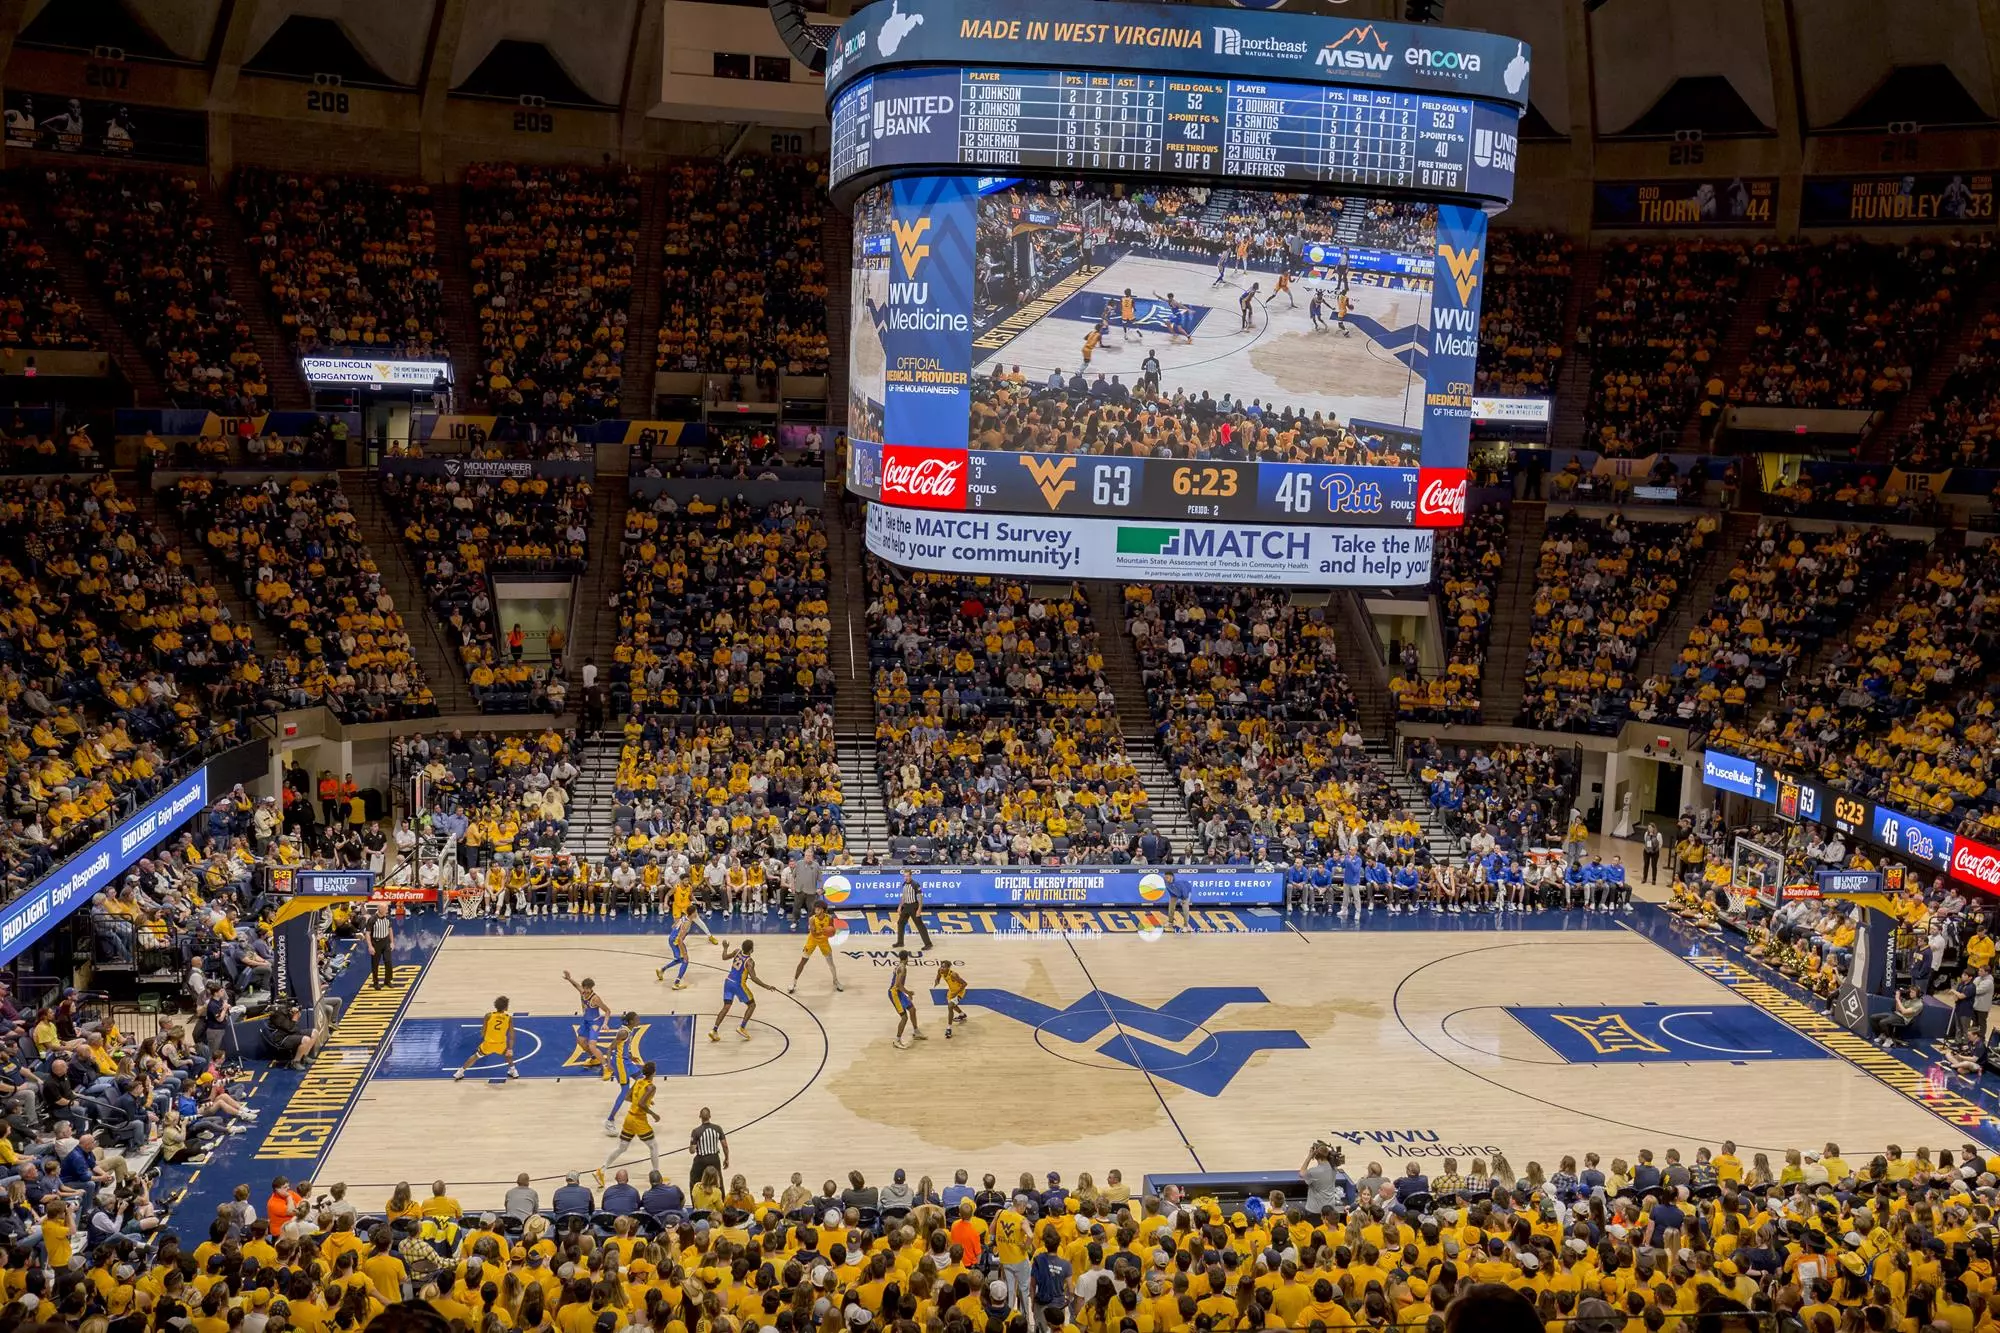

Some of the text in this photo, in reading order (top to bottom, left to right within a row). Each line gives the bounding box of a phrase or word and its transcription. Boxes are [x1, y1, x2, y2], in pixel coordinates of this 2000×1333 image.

[960, 20, 1202, 49] MADE IN WEST VIRGINIA
[1241, 36, 1307, 53] northeast
[1315, 49, 1394, 71] MSW
[1404, 47, 1480, 72] encova
[969, 72, 1134, 86] PLAYER PTS. REB. AST.
[1415, 69, 1469, 79] INSURANCE
[979, 87, 1021, 100] JOHNSON
[1170, 83, 1212, 92] FIELD GOAL
[1237, 85, 1392, 104] PLAYER PTS. REB. AST.
[307, 90, 349, 114] 208
[887, 96, 954, 116] UNITED
[978, 102, 1020, 116] JOHNSON
[1188, 94, 1202, 110] 52
[1245, 100, 1285, 114] ODUKALE
[1422, 102, 1460, 112] FIELD GOAL
[513, 111, 553, 133] 209
[886, 116, 931, 136] BANK
[978, 118, 1017, 132] BRIDGES
[1168, 114, 1199, 122] 3-POINT
[1244, 115, 1279, 130] SANTOS
[1433, 112, 1455, 129] 52.9
[1183, 123, 1205, 140] 42.1
[1231, 130, 1272, 145] 15 GUEYE
[1419, 131, 1446, 140] 3-POINT
[771, 134, 802, 154] 210
[977, 134, 1020, 148] SHERMAN
[1166, 144, 1218, 153] FREE THROWS
[1435, 141, 1448, 158] 40
[976, 150, 1021, 164] COTTRELL
[1175, 153, 1210, 170] 3 OF 8
[1228, 146, 1276, 160] 23 HUGLEY
[1669, 145, 1704, 165] 215
[1228, 162, 1285, 177] 24 JEFFRESS
[1418, 160, 1463, 171] FREE THROWS
[1422, 169, 1457, 187] 8 OF 13
[1639, 186, 1659, 200] ROD
[1853, 182, 1900, 196] HOT ROD
[1638, 200, 1701, 222] THORN
[1745, 198, 1770, 221] 44
[1851, 194, 1944, 219] HUNDLEY
[1969, 193, 1993, 216] 33
[890, 282, 928, 305] WVU
[1434, 308, 1475, 332] WVU
[897, 357, 944, 371] OFFICIAL
[915, 371, 967, 384] PROVIDER
[905, 384, 959, 394] MOUNTAINEERS
[464, 462, 532, 470] MOUNTAINEER
[970, 456, 987, 466] TOL
[882, 455, 963, 496] Coca-Cola
[975, 467, 982, 479] 3
[1402, 473, 1417, 483] TOL
[968, 484, 997, 494] FOULS
[1092, 464, 1131, 506] 63
[1172, 468, 1238, 497] 6:23
[1906, 474, 1929, 490] 112
[975, 494, 981, 506] 9
[1275, 472, 1312, 513] 46
[1320, 473, 1382, 514] Pitt
[1391, 500, 1415, 510] FOULS
[1406, 511, 1412, 523] 4
[885, 511, 1072, 548] Take the MATCH Survey
[891, 534, 1080, 570] help your community!
[1184, 528, 1311, 559] MATCH
[1332, 534, 1410, 553] Take the
[1249, 561, 1286, 570] Community
[1320, 555, 1355, 573] and
[1362, 556, 1401, 579] help
[1715, 768, 1752, 785] uscellular
[158, 784, 200, 825] Enjoy Responsibly
[1800, 786, 1814, 813] 63
[1835, 797, 1864, 826] 6:23
[122, 817, 156, 851] BUD LIGHT
[1882, 818, 1898, 847] 46
[1906, 827, 1934, 860] Pitt
[52, 852, 110, 907] Enjoy Responsibly
[274, 870, 291, 879] 6:23
[995, 877, 1104, 888] OFFICIAL ENERGY PARTNER
[1012, 889, 1086, 900] OF WVU ATHLETICS
[1, 896, 48, 944] BUD LIGHT
[866, 912, 998, 933] WEST
[1010, 910, 1249, 933] VIRGINIA
[494, 1018, 501, 1031] 2
[1728, 983, 1999, 1126] VIRGINIA MOUNTAINEERS
[282, 1050, 375, 1114] VIRGINIA
[254, 1116, 338, 1159] WEST
[1364, 1130, 1439, 1143] WVU
